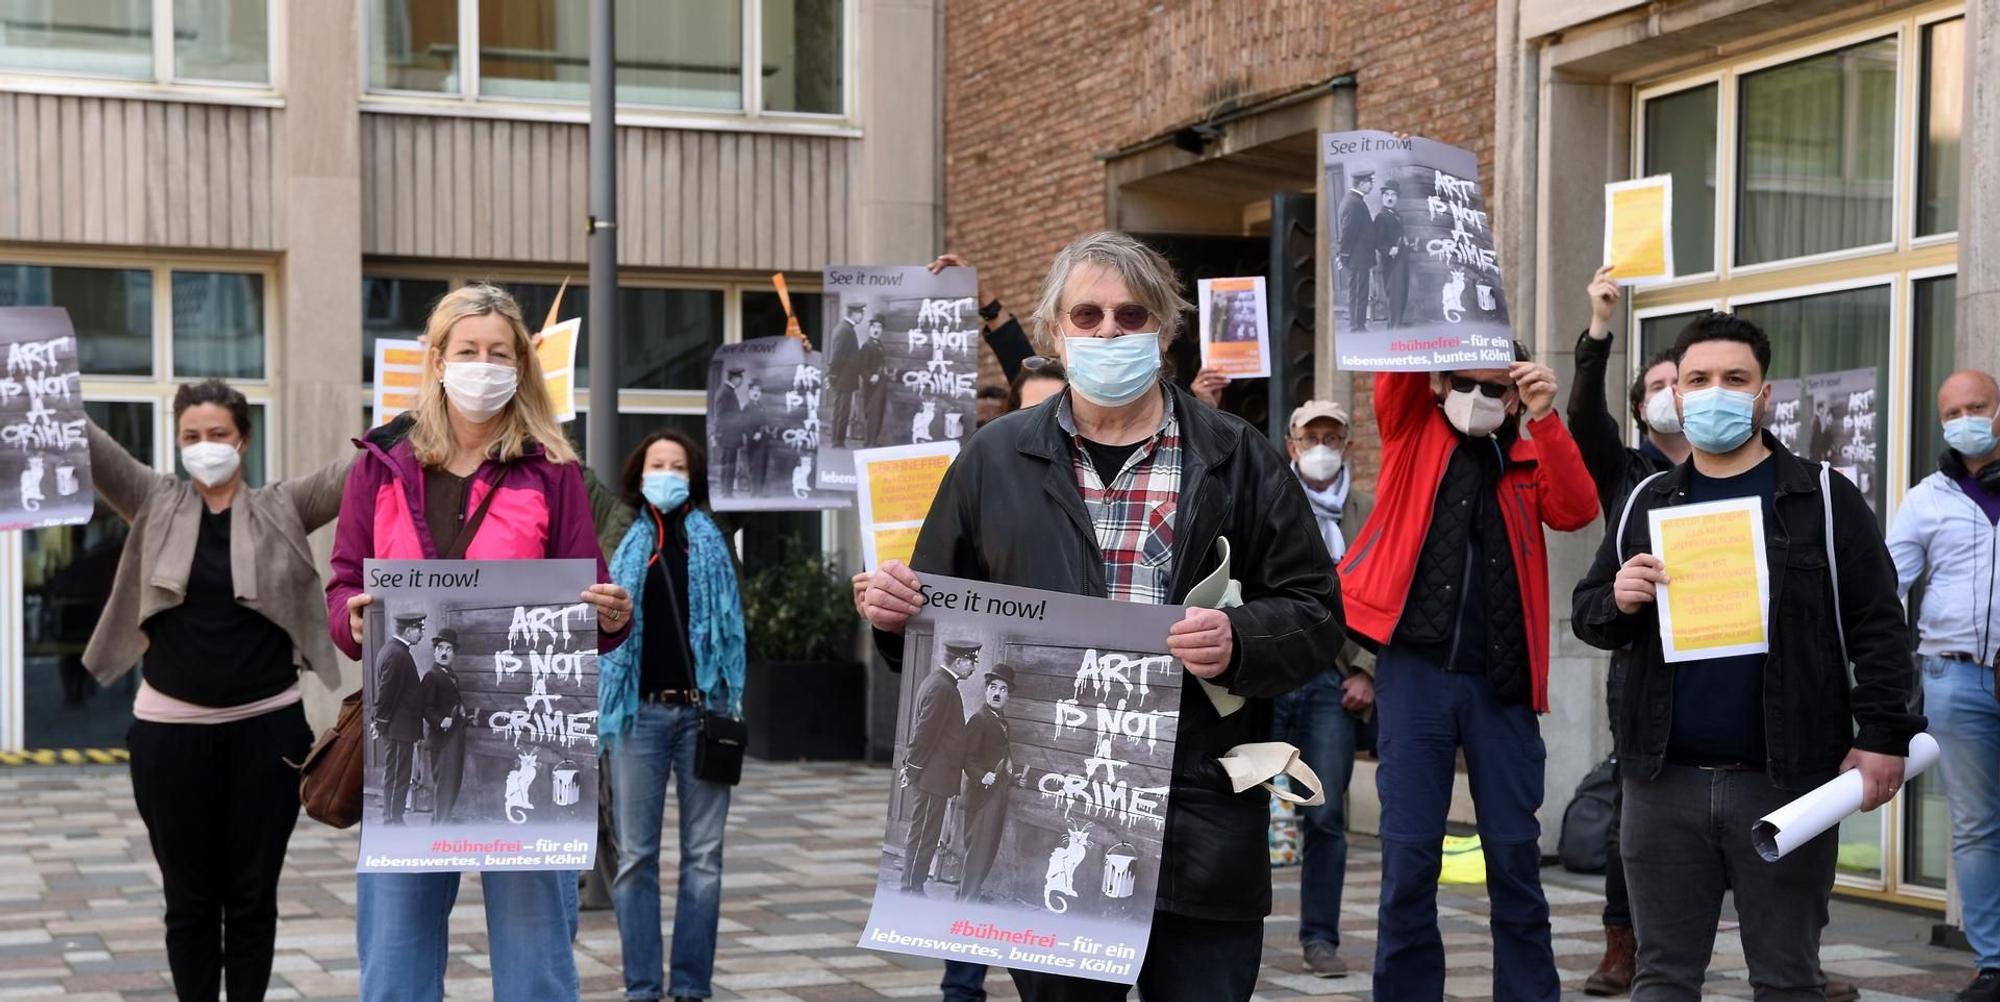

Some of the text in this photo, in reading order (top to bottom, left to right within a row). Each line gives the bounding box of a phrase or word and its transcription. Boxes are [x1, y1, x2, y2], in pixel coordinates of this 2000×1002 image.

[1330, 137, 1412, 155] See it now!
[1434, 170, 1478, 203] ART
[1428, 196, 1486, 232] IS NOT
[1451, 219, 1473, 246] A
[1426, 239, 1500, 273] CRIME
[829, 271, 904, 287] See it now!
[918, 297, 973, 329] ART
[7, 336, 69, 375] ART
[908, 326, 979, 357] IS NOT
[1391, 336, 1460, 352] #bühnefrei
[1471, 334, 1490, 347] für
[1491, 335, 1509, 348] ein
[927, 349, 953, 374] A
[1342, 349, 1511, 367] lebenswertes, buntes Köln!
[26, 371, 81, 402] NOT
[793, 364, 821, 387] AR
[902, 371, 978, 399] CRIME
[26, 394, 56, 425] A
[785, 390, 803, 413] IS
[1775, 400, 1800, 420] ART
[1848, 389, 1874, 411] ART
[1, 418, 87, 450] CRIME
[1780, 421, 1801, 439] NOT
[1854, 411, 1876, 430] NOT
[782, 428, 820, 449] CRI
[1841, 443, 1876, 462] CRIME
[821, 471, 856, 483] lebens
[369, 568, 480, 588] See it now!
[919, 584, 1046, 620] See it now!
[508, 603, 588, 649] ART
[495, 644, 598, 687] IS NOT
[1074, 649, 1173, 707] ART
[524, 678, 562, 714] A
[489, 710, 598, 748] CRIME
[1054, 699, 1179, 755] IS NOT
[1084, 740, 1129, 782] A
[1038, 773, 1170, 831] CRIME
[366, 854, 587, 867] lebenswertes, buntes Köln!
[431, 839, 521, 853] #bühnefrei
[535, 838, 558, 853] für
[563, 840, 588, 853] ein
[871, 928, 1131, 975] lebenswertes, buntes Köln!
[950, 920, 1056, 948] #bühnefrei
[1072, 936, 1103, 955] für
[1105, 942, 1135, 959] ein
